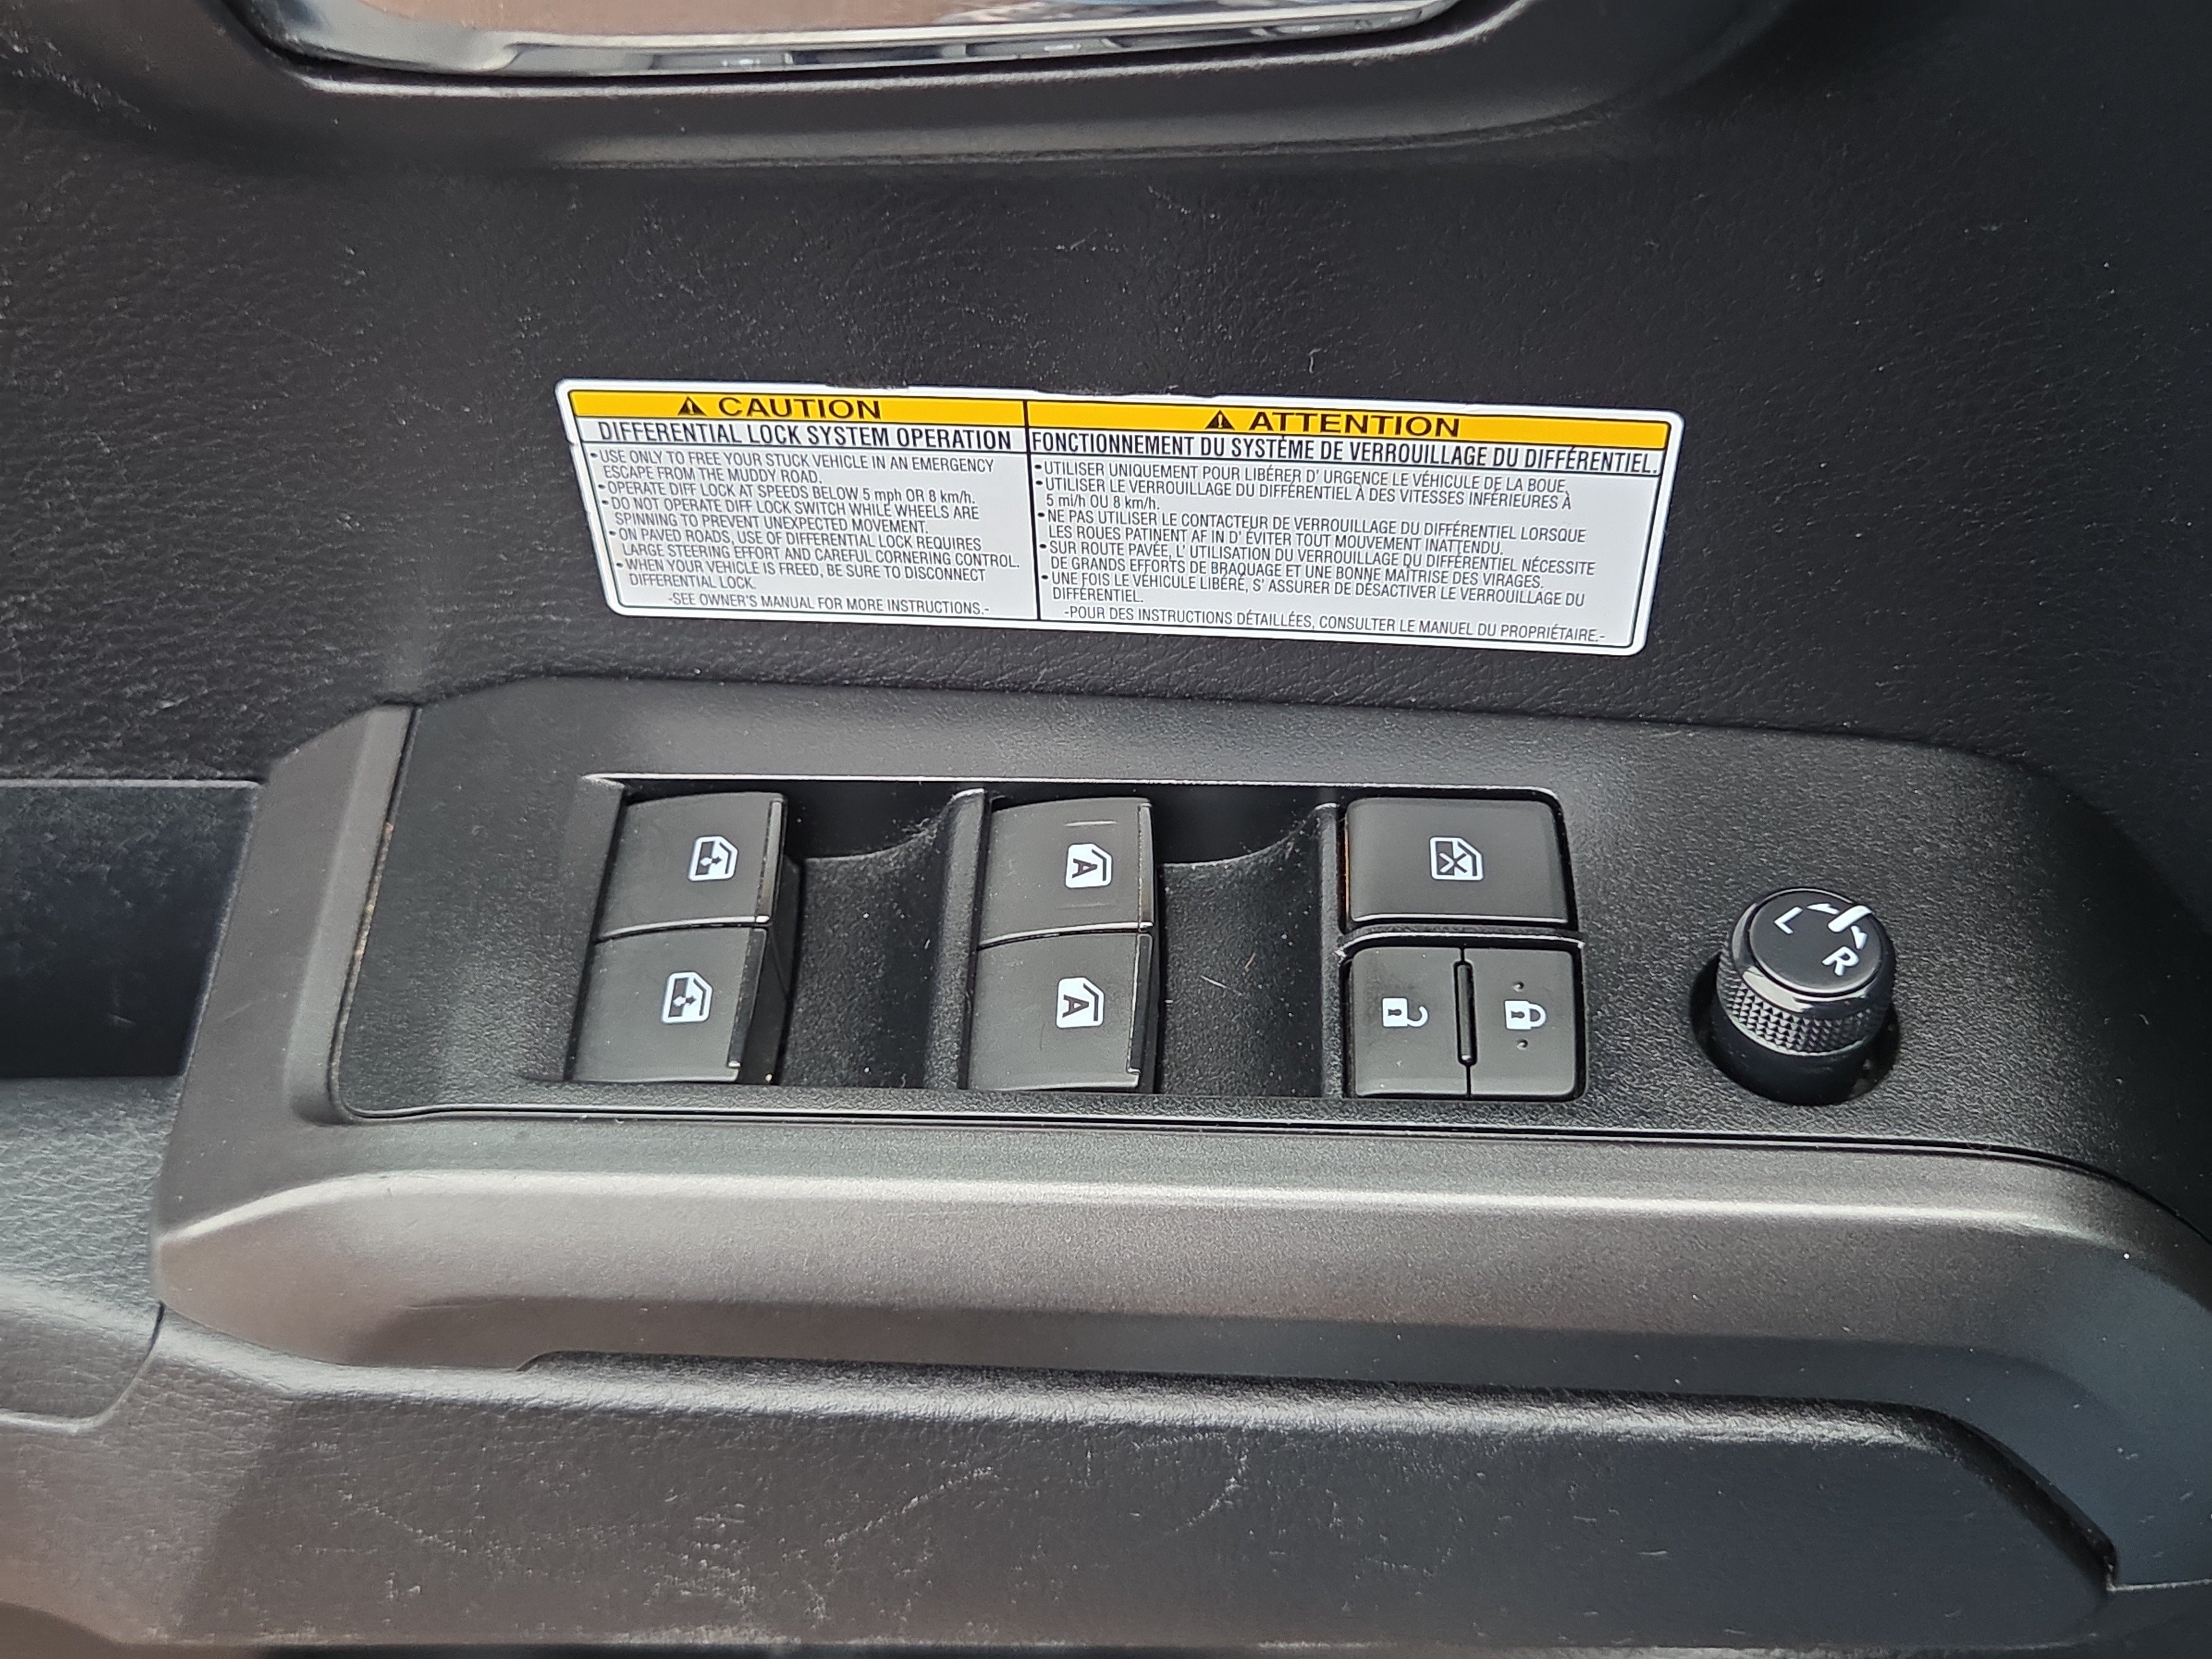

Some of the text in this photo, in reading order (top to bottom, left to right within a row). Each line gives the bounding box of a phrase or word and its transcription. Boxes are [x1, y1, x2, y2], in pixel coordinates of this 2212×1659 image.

[717, 397, 881, 419] CAUTION
[597, 420, 1011, 451] DIFFERENTIAL LOCK SYSTEM OPERATION
[1249, 411, 1459, 436] ATTENTION
[599, 448, 994, 472] USE ONLY TO FREE YOUR STUCK VEHICLE IN AN EMERGENCY
[1031, 431, 1194, 456] FONCTIONNEMENT
[1200, 437, 1224, 457] DU
[1320, 442, 1343, 462] DE
[1348, 442, 1490, 467] VERROUILLAGE
[1491, 448, 1519, 468] DU
[602, 464, 822, 484] ESCAPE FROM THE MUDDY ROAD.
[1044, 460, 1104, 477] UTILISER
[1109, 462, 1198, 481] UNIQUEMENT
[1203, 465, 1240, 481] POUR
[1245, 462, 1301, 483] LIBÉRER
[1392, 472, 1409, 487] LE
[1411, 468, 1481, 490] VÉHICULE
[1483, 475, 1502, 491] DE
[1506, 477, 1525, 492] LA
[606, 480, 975, 506] OPERATE DIFF LOCK AT SPEEDS BELOW 5 mph OR 8 km/h.
[1045, 475, 1105, 492] UTILISER
[1109, 478, 1125, 492] LE
[1128, 478, 1231, 497] VERROUILLAGE
[1236, 482, 1255, 497] DU
[1259, 479, 1353, 501] DIFFÉRENTIEL
[1368, 487, 1396, 503] DES
[1398, 488, 1465, 505] VITESSES
[1468, 487, 1560, 509] INFÉRIEURES
[1046, 493, 1159, 511] 5 mi/h OU 8 km/h.
[610, 495, 979, 519] DO NOT OPERATE DIFF LOCK SWITCH WHILE WHEELS ARE
[614, 511, 928, 533] SPINNING TO PREVENT UNEXPECTED MOVEMENT.
[1047, 507, 1587, 544] NE PAS UTILISER LE CONTACTEUR DE VERROUILLAGE DU DIFFÉRENTIEL LORSQUE
[618, 526, 981, 551] ON PAVED ROADS, USE OF DIFFERENTIAL LOCK REQUIRES
[621, 542, 1019, 567] LARGE STEERING EFFORT AND CAREFUL CORNERING CONTROL.
[624, 557, 986, 581] WHEN YOUR VEHICLE IS FREED, BE SURE TO DISCONNECT
[628, 572, 717, 588] DIFFERENTIAL
[1051, 555, 1068, 569] DE
[1071, 555, 1126, 571] GRANDS
[1129, 558, 1185, 574] EFFORTS
[1190, 560, 1206, 575] DE
[1211, 561, 1282, 579] BRAQUAGE
[1285, 564, 1302, 578] ET
[1305, 565, 1332, 580] UNE
[1335, 567, 1381, 582] BONNE
[1452, 571, 1479, 587] DES
[1481, 573, 1545, 589] VIRAGES.
[699, 593, 757, 607] OWNER'S
[760, 594, 815, 608] MANUAL
[817, 596, 843, 609] FOR
[846, 597, 884, 610] MORE
[1109, 606, 1134, 620] DES
[1138, 608, 1232, 625] INSTRUCTIONS
[1237, 608, 1315, 631] DÉTAILLÉES,
[1319, 615, 1396, 632] CONSULTER
[1399, 619, 1415, 633] LE
[1418, 620, 1474, 636] MANUEL
[1477, 623, 1496, 637] DU
[1071, 858, 1098, 879] A
[1773, 906, 1804, 935] L
[1822, 946, 1860, 976] R
[1062, 994, 1089, 1018] A
